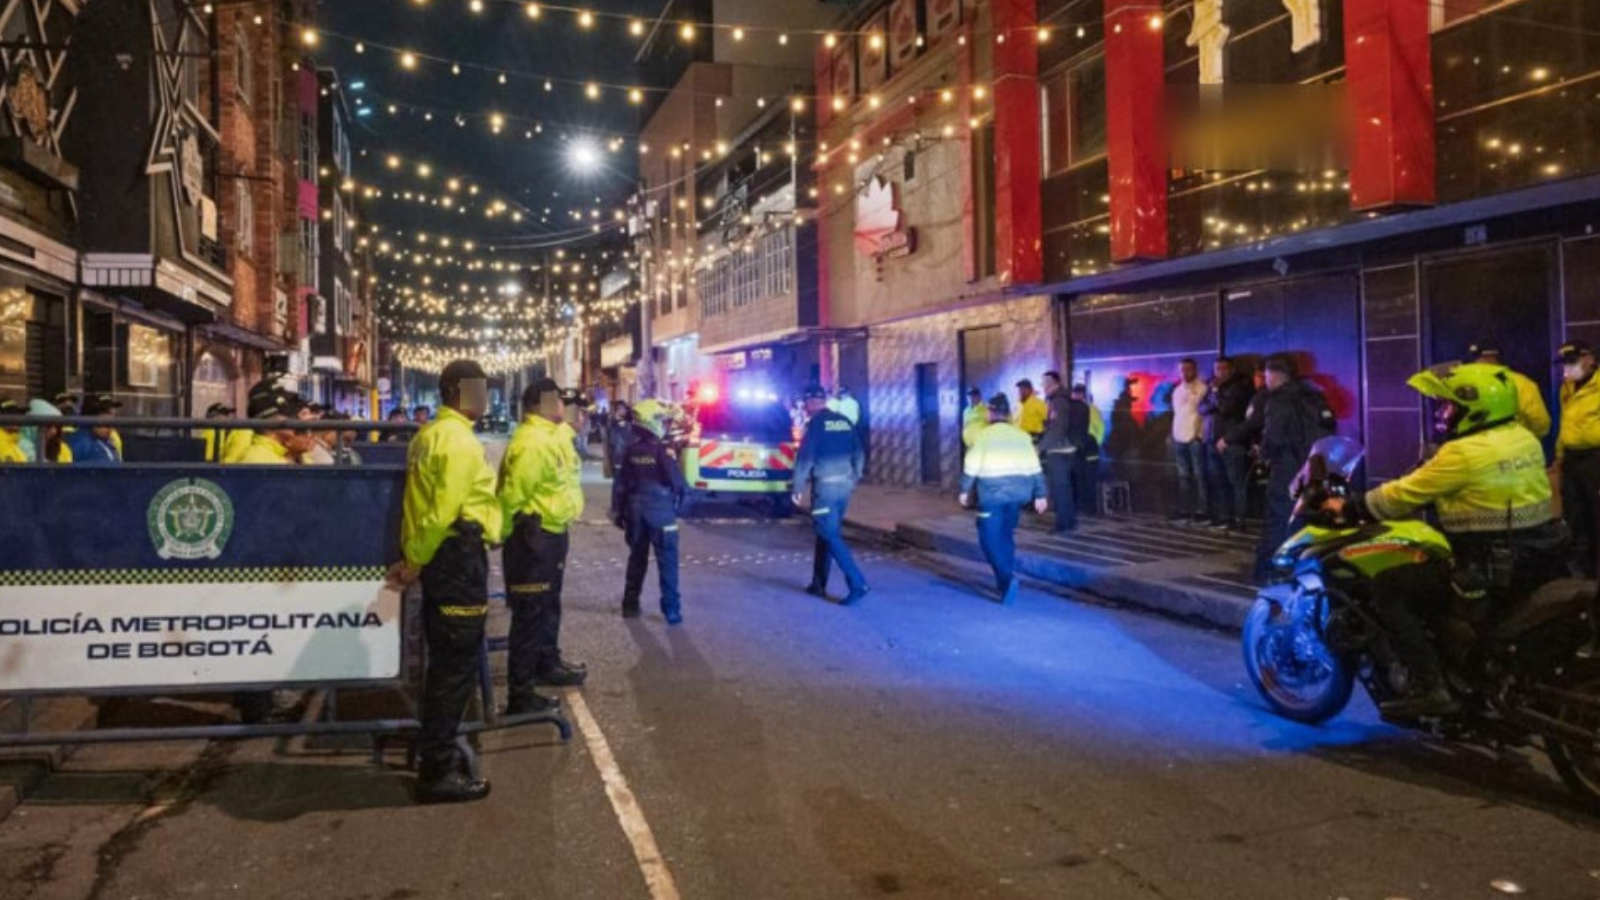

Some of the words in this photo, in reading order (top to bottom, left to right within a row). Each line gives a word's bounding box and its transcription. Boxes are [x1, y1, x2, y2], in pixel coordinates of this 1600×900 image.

[0, 611, 104, 636] OLICÍA
[111, 611, 383, 633] METROPOLITANA
[87, 643, 131, 660] DE
[138, 633, 273, 659] BOGOTÁ
